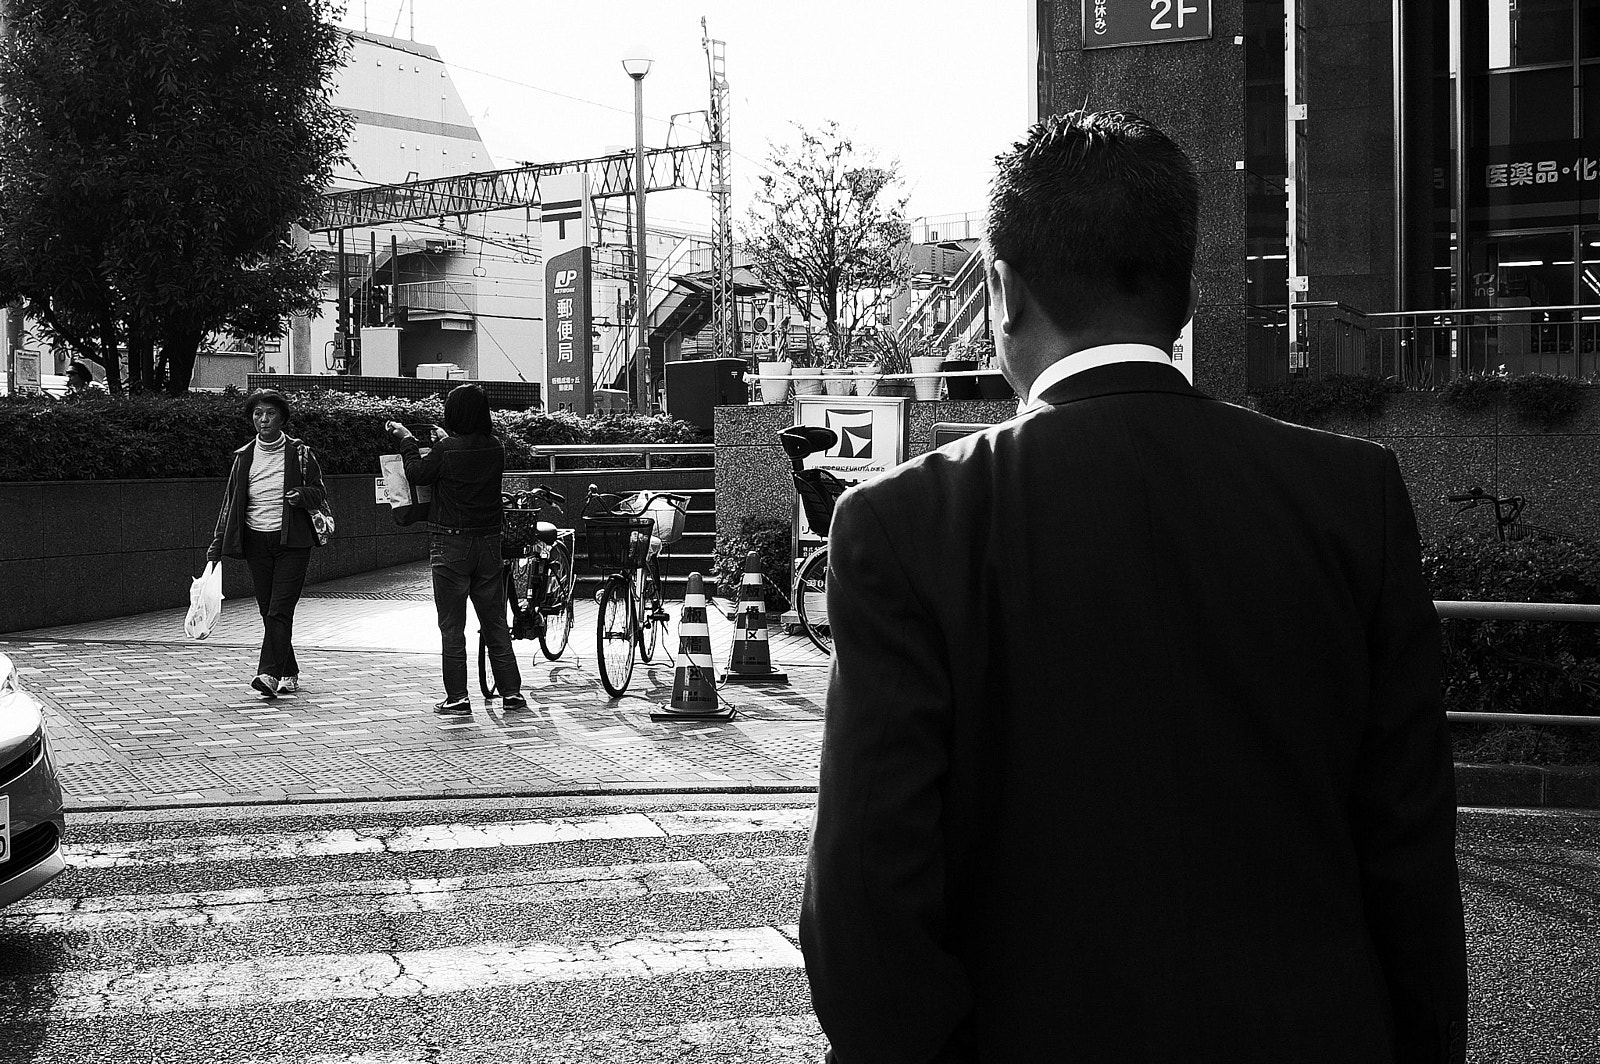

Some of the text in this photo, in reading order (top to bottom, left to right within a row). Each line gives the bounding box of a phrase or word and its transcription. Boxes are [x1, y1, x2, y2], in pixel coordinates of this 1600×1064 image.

[1150, 0, 1198, 30] 2F
[1486, 157, 1600, 188] 医薬品・化
[557, 298, 574, 363] 郵便局
